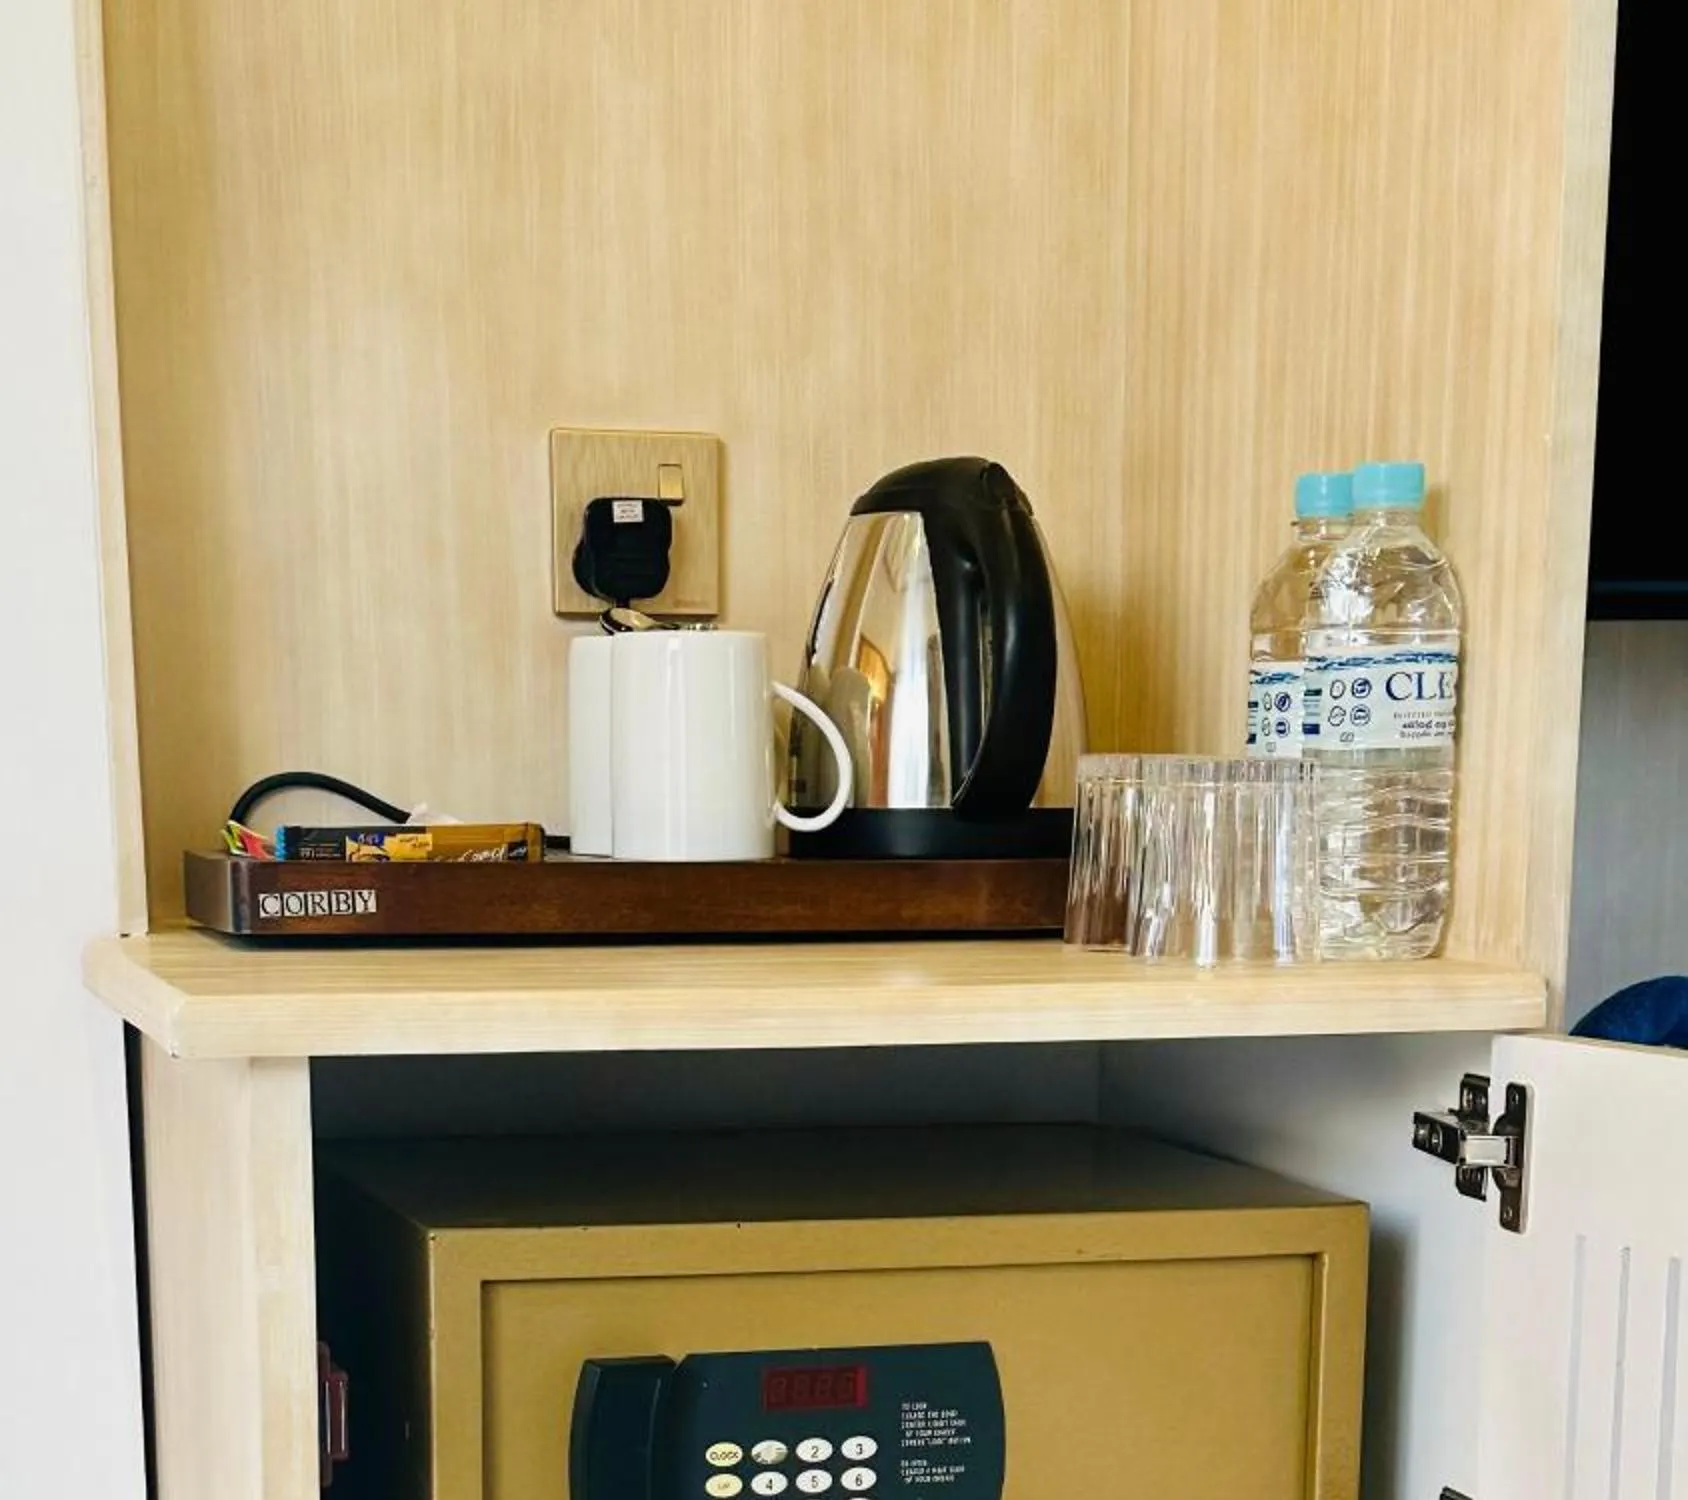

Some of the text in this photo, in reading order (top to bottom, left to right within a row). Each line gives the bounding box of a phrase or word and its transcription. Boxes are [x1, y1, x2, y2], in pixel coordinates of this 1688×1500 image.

[260, 889, 376, 917] CORBY
[810, 1445, 819, 1457] 2
[855, 1443, 863, 1456] 3
[764, 1477, 774, 1491] 4
[810, 1476, 819, 1488] 5
[854, 1474, 863, 1486] 6
